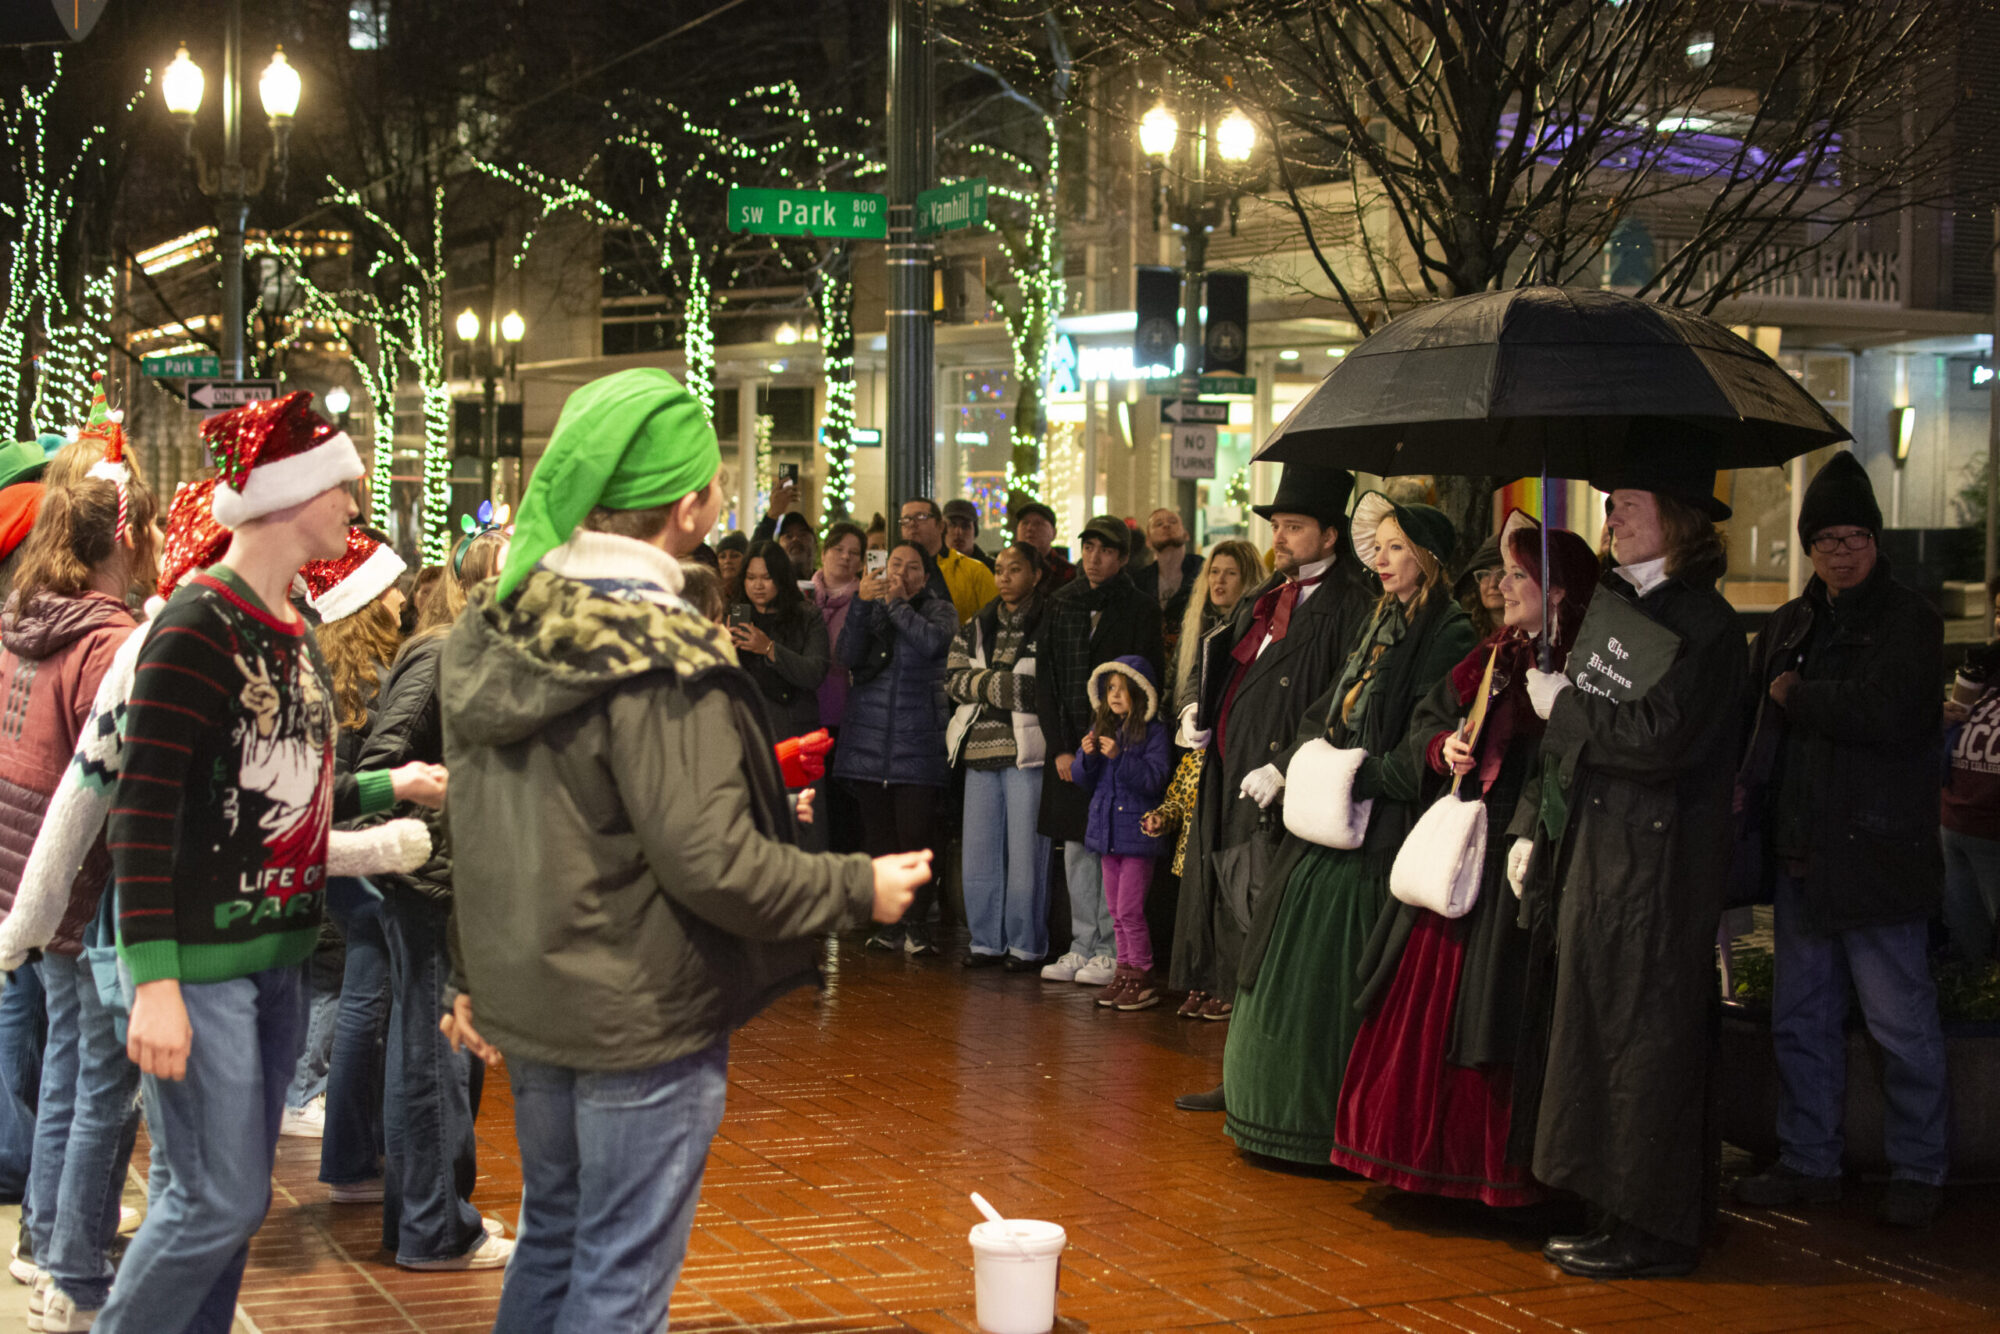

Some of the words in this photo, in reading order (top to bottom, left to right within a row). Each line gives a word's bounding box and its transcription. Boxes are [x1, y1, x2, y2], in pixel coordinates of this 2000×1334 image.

[741, 205, 764, 224] SW
[778, 199, 836, 227] Park
[853, 199, 877, 213] 800
[931, 191, 969, 226] Yamhill
[1816, 249, 1900, 283] BANK
[164, 360, 195, 373] Park
[214, 390, 236, 400] ONE
[243, 390, 269, 401] WAY
[1184, 435, 1206, 451] NO
[1174, 456, 1215, 471] TURNS
[1607, 636, 1630, 660] The
[1586, 651, 1633, 689] Dickens
[1576, 671, 1619, 705] Carol
[240, 868, 296, 892] LIFE
[303, 865, 322, 885] OF
